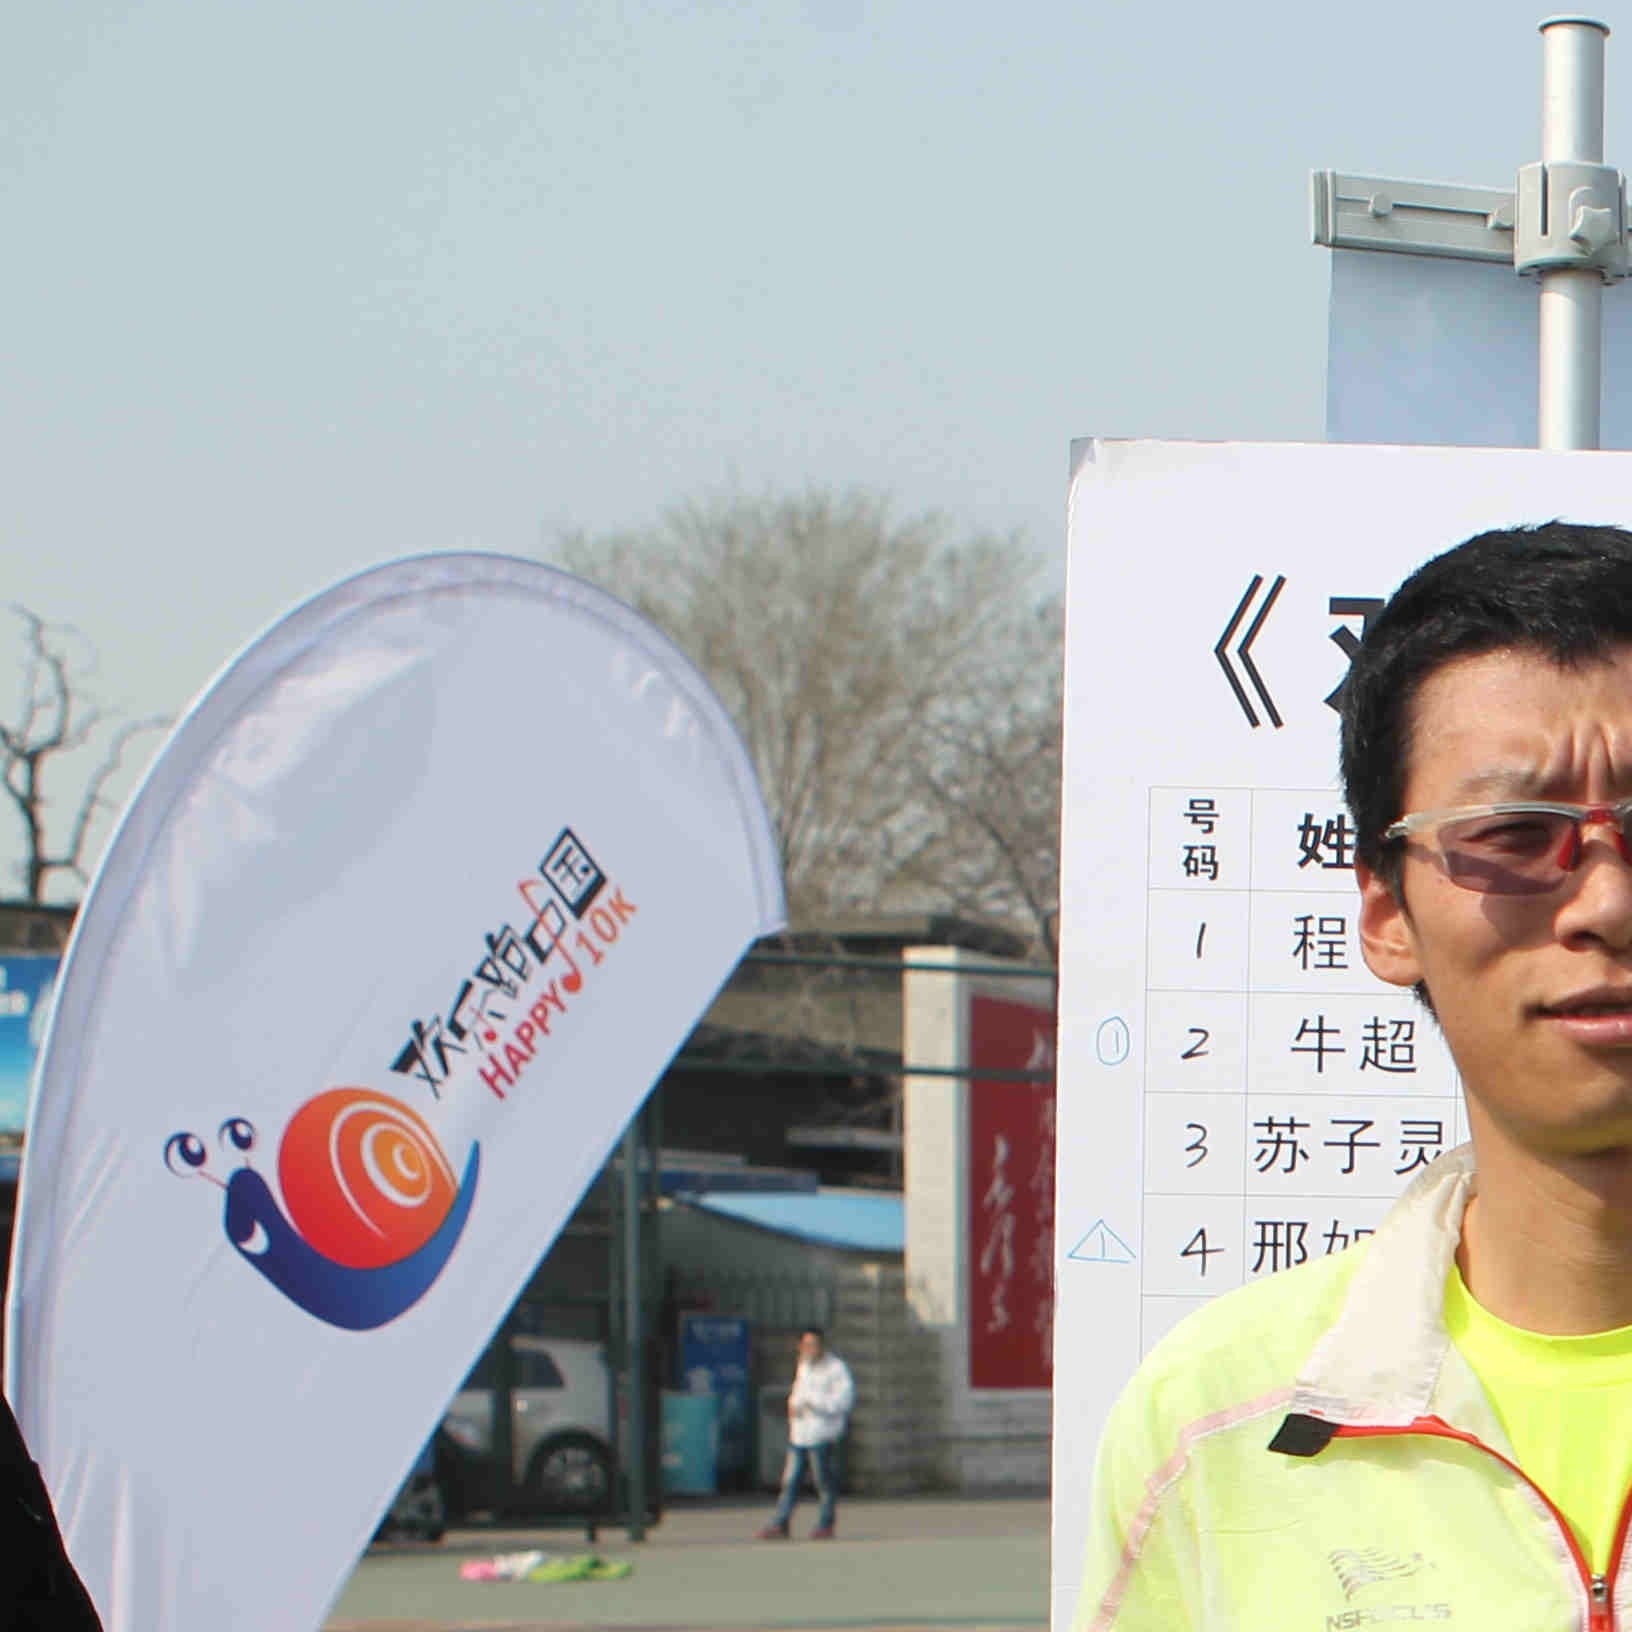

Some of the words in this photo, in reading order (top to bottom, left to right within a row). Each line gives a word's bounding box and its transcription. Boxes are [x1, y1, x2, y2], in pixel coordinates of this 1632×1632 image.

[1183, 799, 1220, 880] 号码
[1297, 813, 1356, 869] 姓
[1197, 923, 1206, 959] 1
[1293, 915, 1349, 970] 程
[479, 980, 567, 1100] HAPPY
[576, 887, 637, 966] 10K
[1181, 1029, 1209, 1059] 2
[1291, 1014, 1418, 1073] 牛超
[1186, 1124, 1207, 1168] 3
[1253, 1116, 1444, 1175] 苏子灵
[1181, 1228, 1224, 1276] 4
